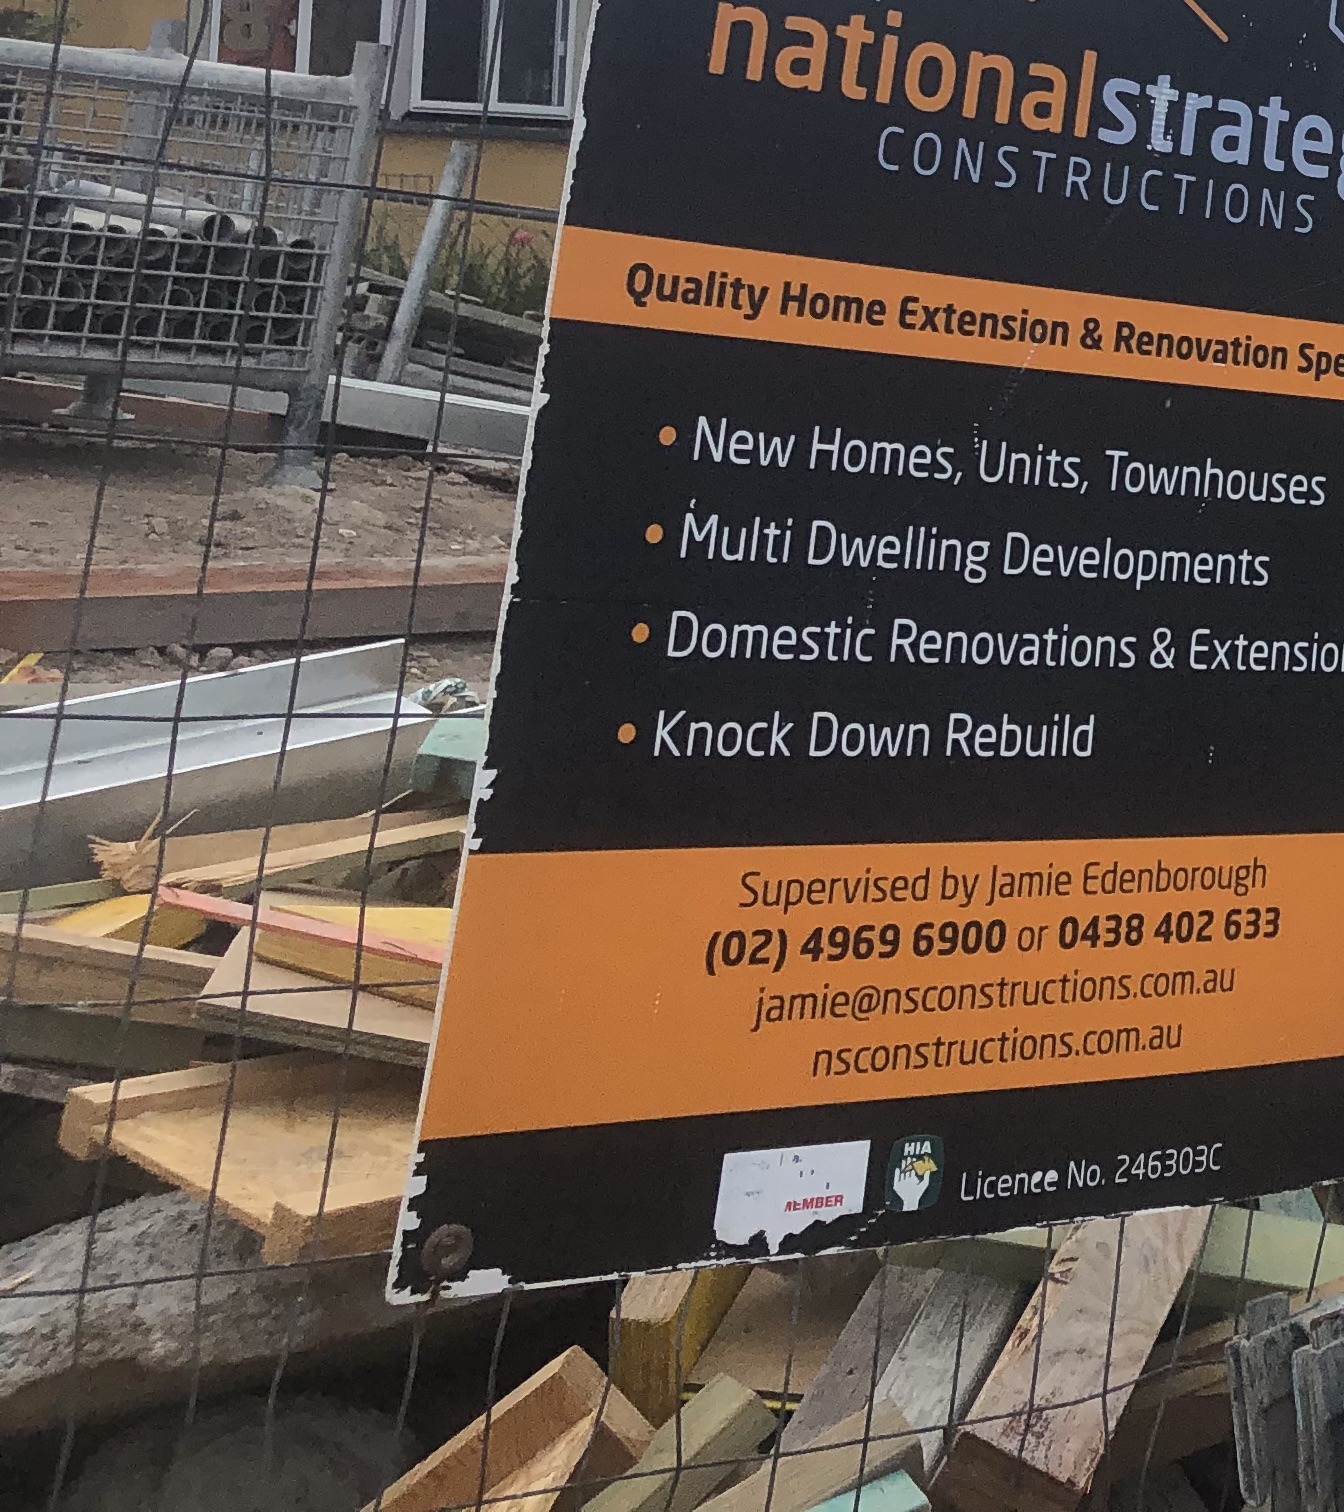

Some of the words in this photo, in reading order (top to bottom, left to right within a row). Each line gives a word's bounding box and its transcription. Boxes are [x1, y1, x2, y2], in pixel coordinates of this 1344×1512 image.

[877, 125, 1317, 234] CONSTRUCTIONS
[626, 263, 770, 320] Quality
[780, 281, 886, 326] Home
[899, 296, 1069, 346] Extension
[1080, 318, 1102, 350] &
[1114, 321, 1287, 370] Renovation
[694, 416, 795, 467] New
[810, 426, 962, 485] Homes,
[978, 437, 1088, 494] Units,
[1106, 450, 1326, 505] Townhouses
[680, 513, 793, 563] Multi
[808, 520, 990, 583] Dwelling
[1004, 532, 1269, 590] Developments
[668, 611, 875, 661] Domestic
[890, 619, 1136, 668] Renovations
[1150, 628, 1175, 668] &
[654, 710, 794, 756] Knock
[809, 712, 929, 756] Down
[946, 713, 1094, 757] Rebuild
[738, 867, 930, 915] Supervised
[941, 866, 979, 907] by
[985, 863, 1071, 906] Jamie
[1083, 857, 1266, 896] Edenborough
[706, 929, 787, 976] (02)
[800, 924, 900, 962] 4969
[913, 919, 1006, 957] 6900
[1018, 926, 1048, 951] or
[1059, 913, 1144, 949] 0438
[1154, 910, 1214, 944] 402
[1224, 907, 1280, 941] 633
[750, 969, 1235, 1033] jamie@nsconstructions.com.au
[813, 1024, 1182, 1077] nsconstructions.com.au
[903, 1140, 932, 1157] HIA
[1067, 1159, 1106, 1189] No.
[1115, 1143, 1222, 1183] 246303C
